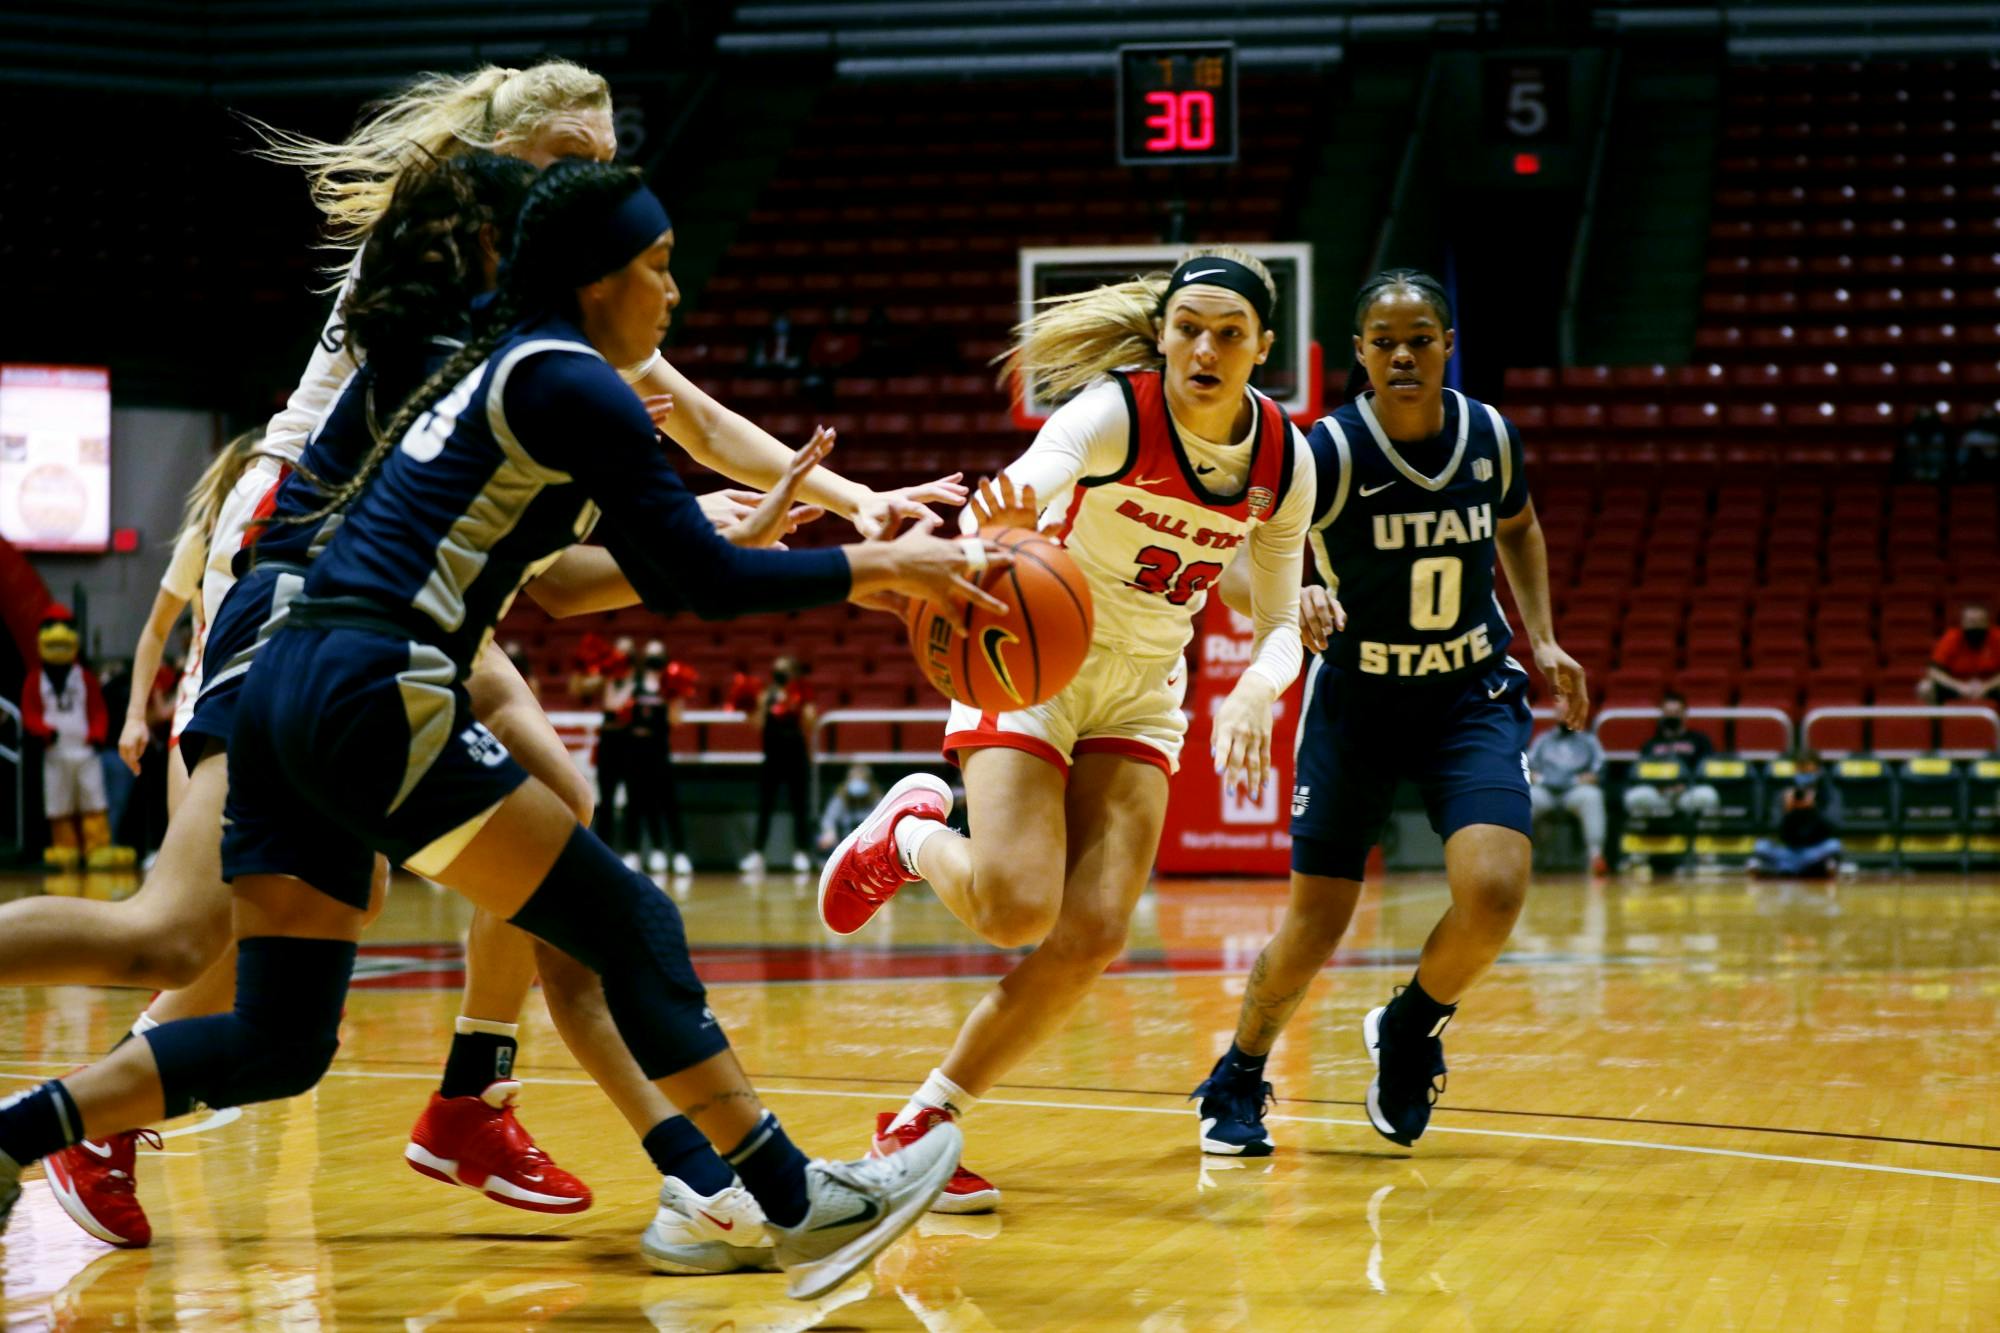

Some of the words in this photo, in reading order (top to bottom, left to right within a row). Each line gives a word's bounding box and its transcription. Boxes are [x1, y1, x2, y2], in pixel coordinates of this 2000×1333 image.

[1144, 91, 1215, 151] 30
[1506, 83, 1547, 135] 5
[1115, 499, 1189, 540] BALL
[1191, 527, 1245, 550] STA
[1372, 502, 1493, 551] UTAH
[1409, 556, 1463, 631] 0
[1358, 622, 1494, 677] STATE
